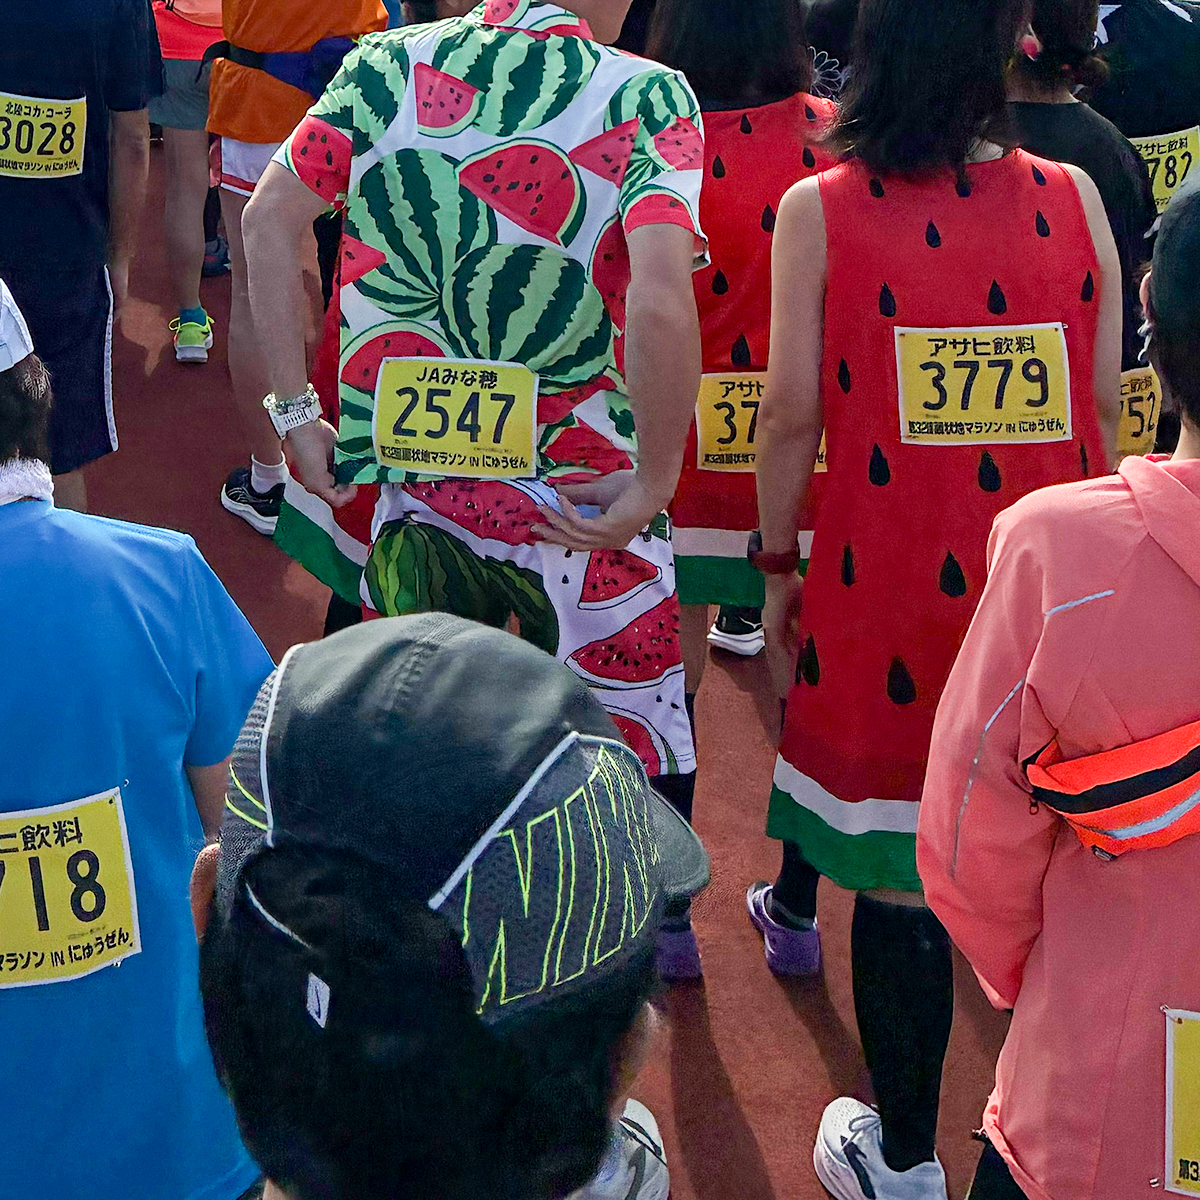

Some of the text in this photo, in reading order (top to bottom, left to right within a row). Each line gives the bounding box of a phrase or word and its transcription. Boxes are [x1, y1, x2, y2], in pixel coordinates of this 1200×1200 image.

[927, 335, 1036, 357] アサヒ飲料
[416, 367, 498, 389] JAみな穂
[919, 358, 1049, 410] 3779
[393, 387, 515, 444] 2547
[714, 401, 760, 444] 37
[482, 454, 528, 469] にゅうぜん
[50, 951, 64, 967] IN
[68, 928, 129, 963] にゅうぜん
